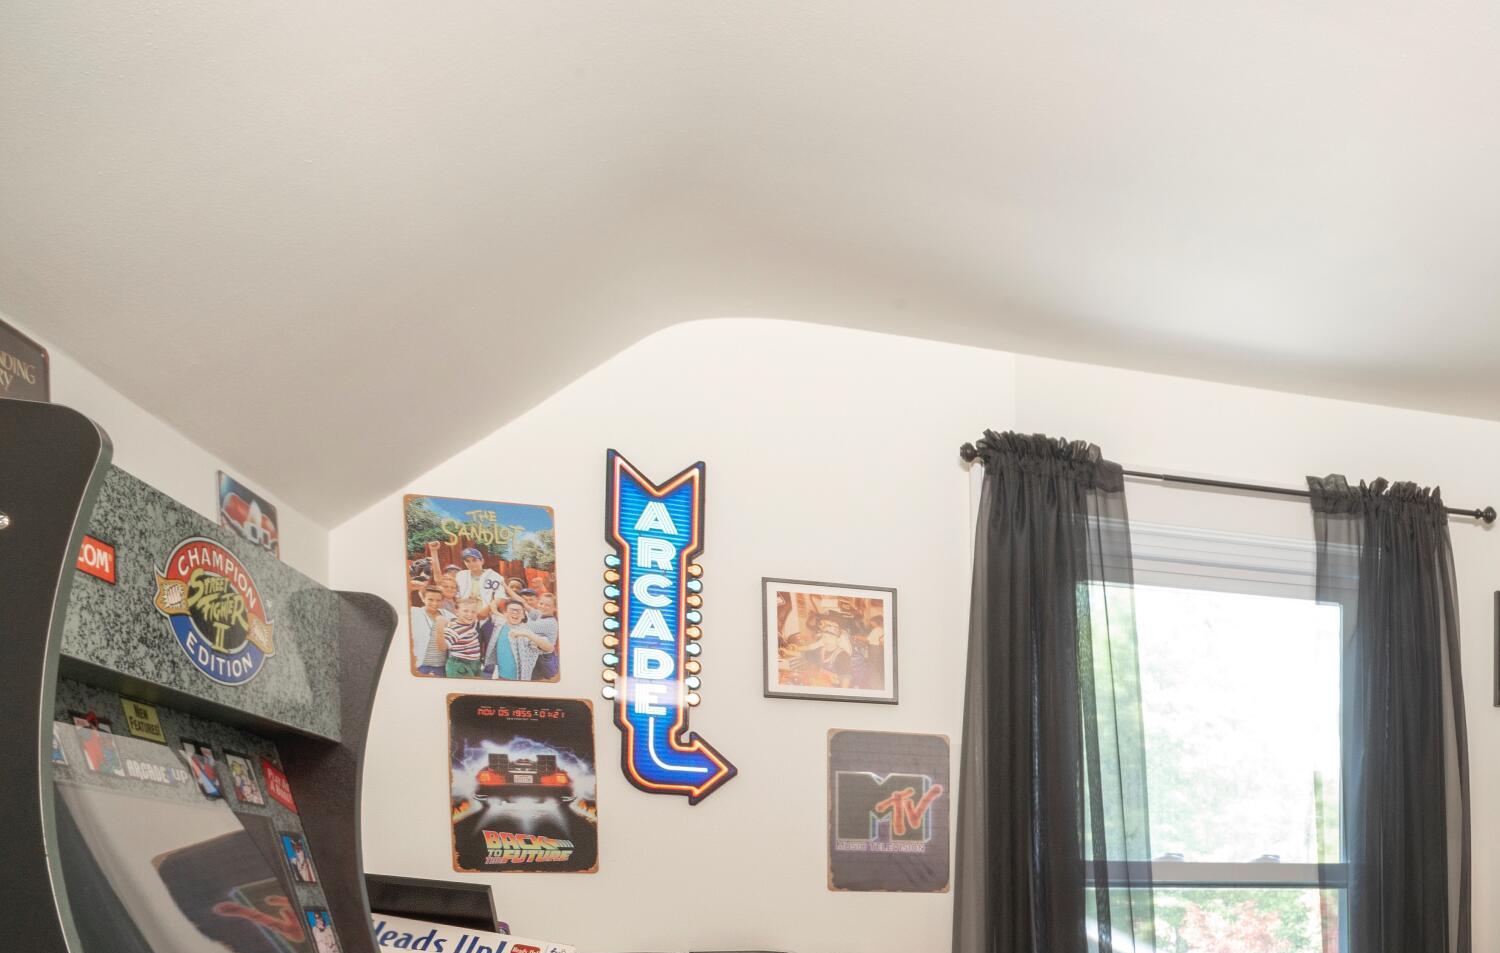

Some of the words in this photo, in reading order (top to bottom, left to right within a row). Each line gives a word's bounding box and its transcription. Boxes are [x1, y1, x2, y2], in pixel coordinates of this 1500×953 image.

[442, 518, 525, 546] SANDLOT
[465, 510, 496, 522] THE
[178, 547, 256, 609] CHAMPION
[187, 568, 231, 607] STREET
[484, 579, 500, 591] 30
[197, 592, 249, 632] FIGHTER
[632, 501, 679, 716] ARCADE
[185, 631, 253, 677] EDITION
[211, 622, 230, 655] II
[836, 770, 943, 843] MTV
[482, 829, 575, 850] BACK
[488, 849, 502, 857] TO
[503, 849, 574, 864] FUTURE
